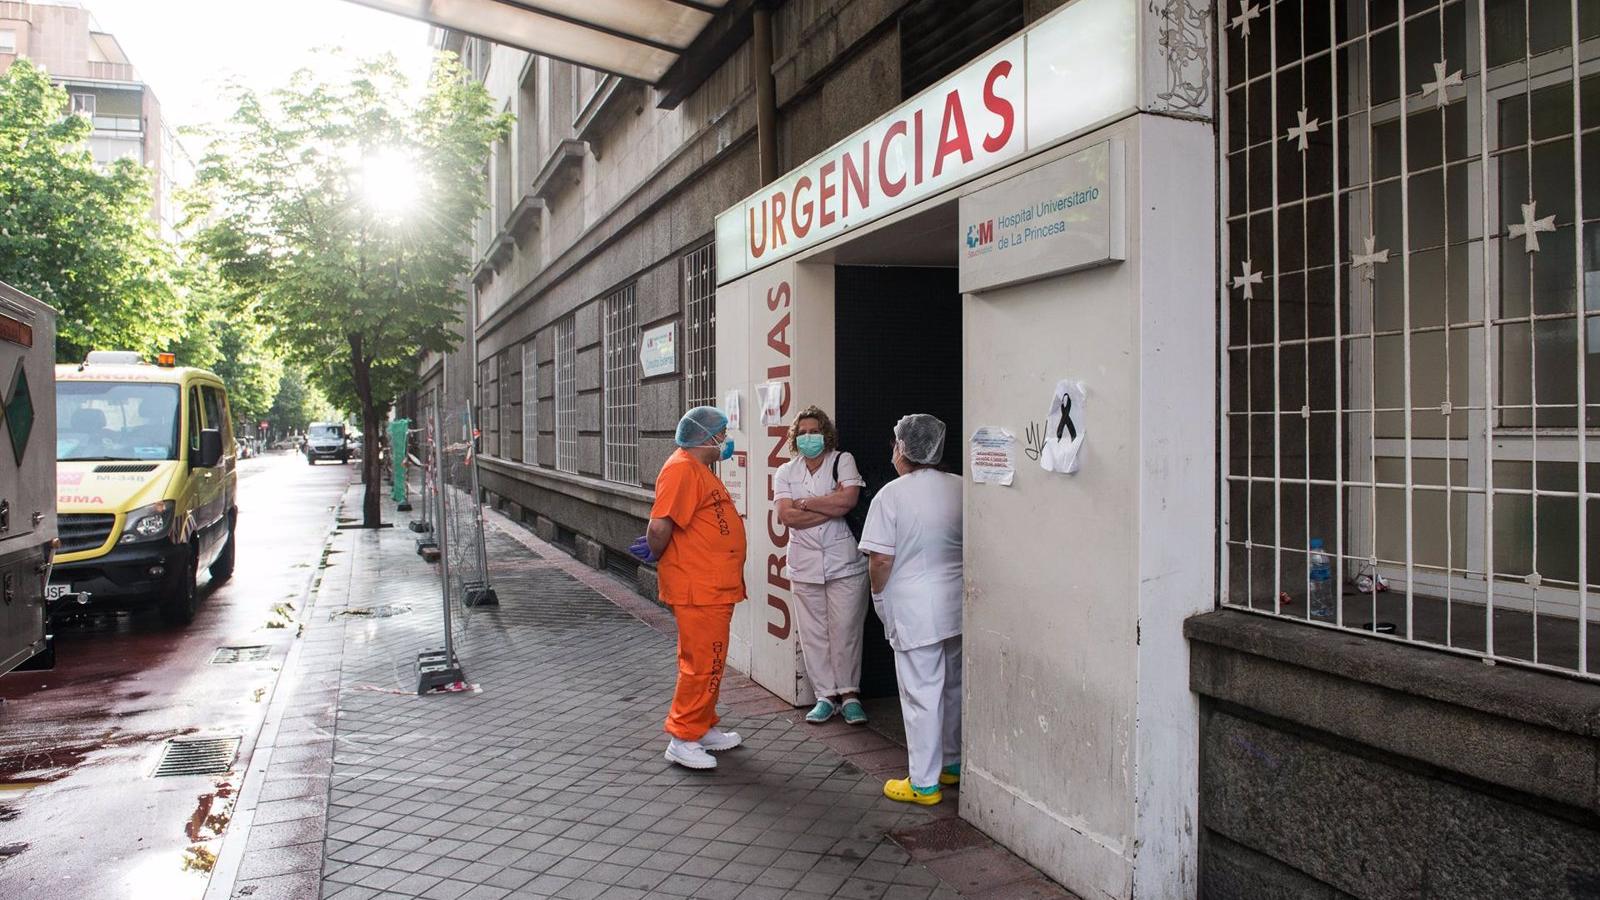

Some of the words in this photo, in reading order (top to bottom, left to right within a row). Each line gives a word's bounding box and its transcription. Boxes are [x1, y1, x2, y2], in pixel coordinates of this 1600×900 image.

[750, 60, 1016, 259] URGENCIAS
[998, 206, 1034, 229] Hospital
[1036, 186, 1099, 217] Universitario
[997, 236, 1009, 250] de
[1011, 233, 1023, 247] La
[1024, 219, 1066, 242] Princesa
